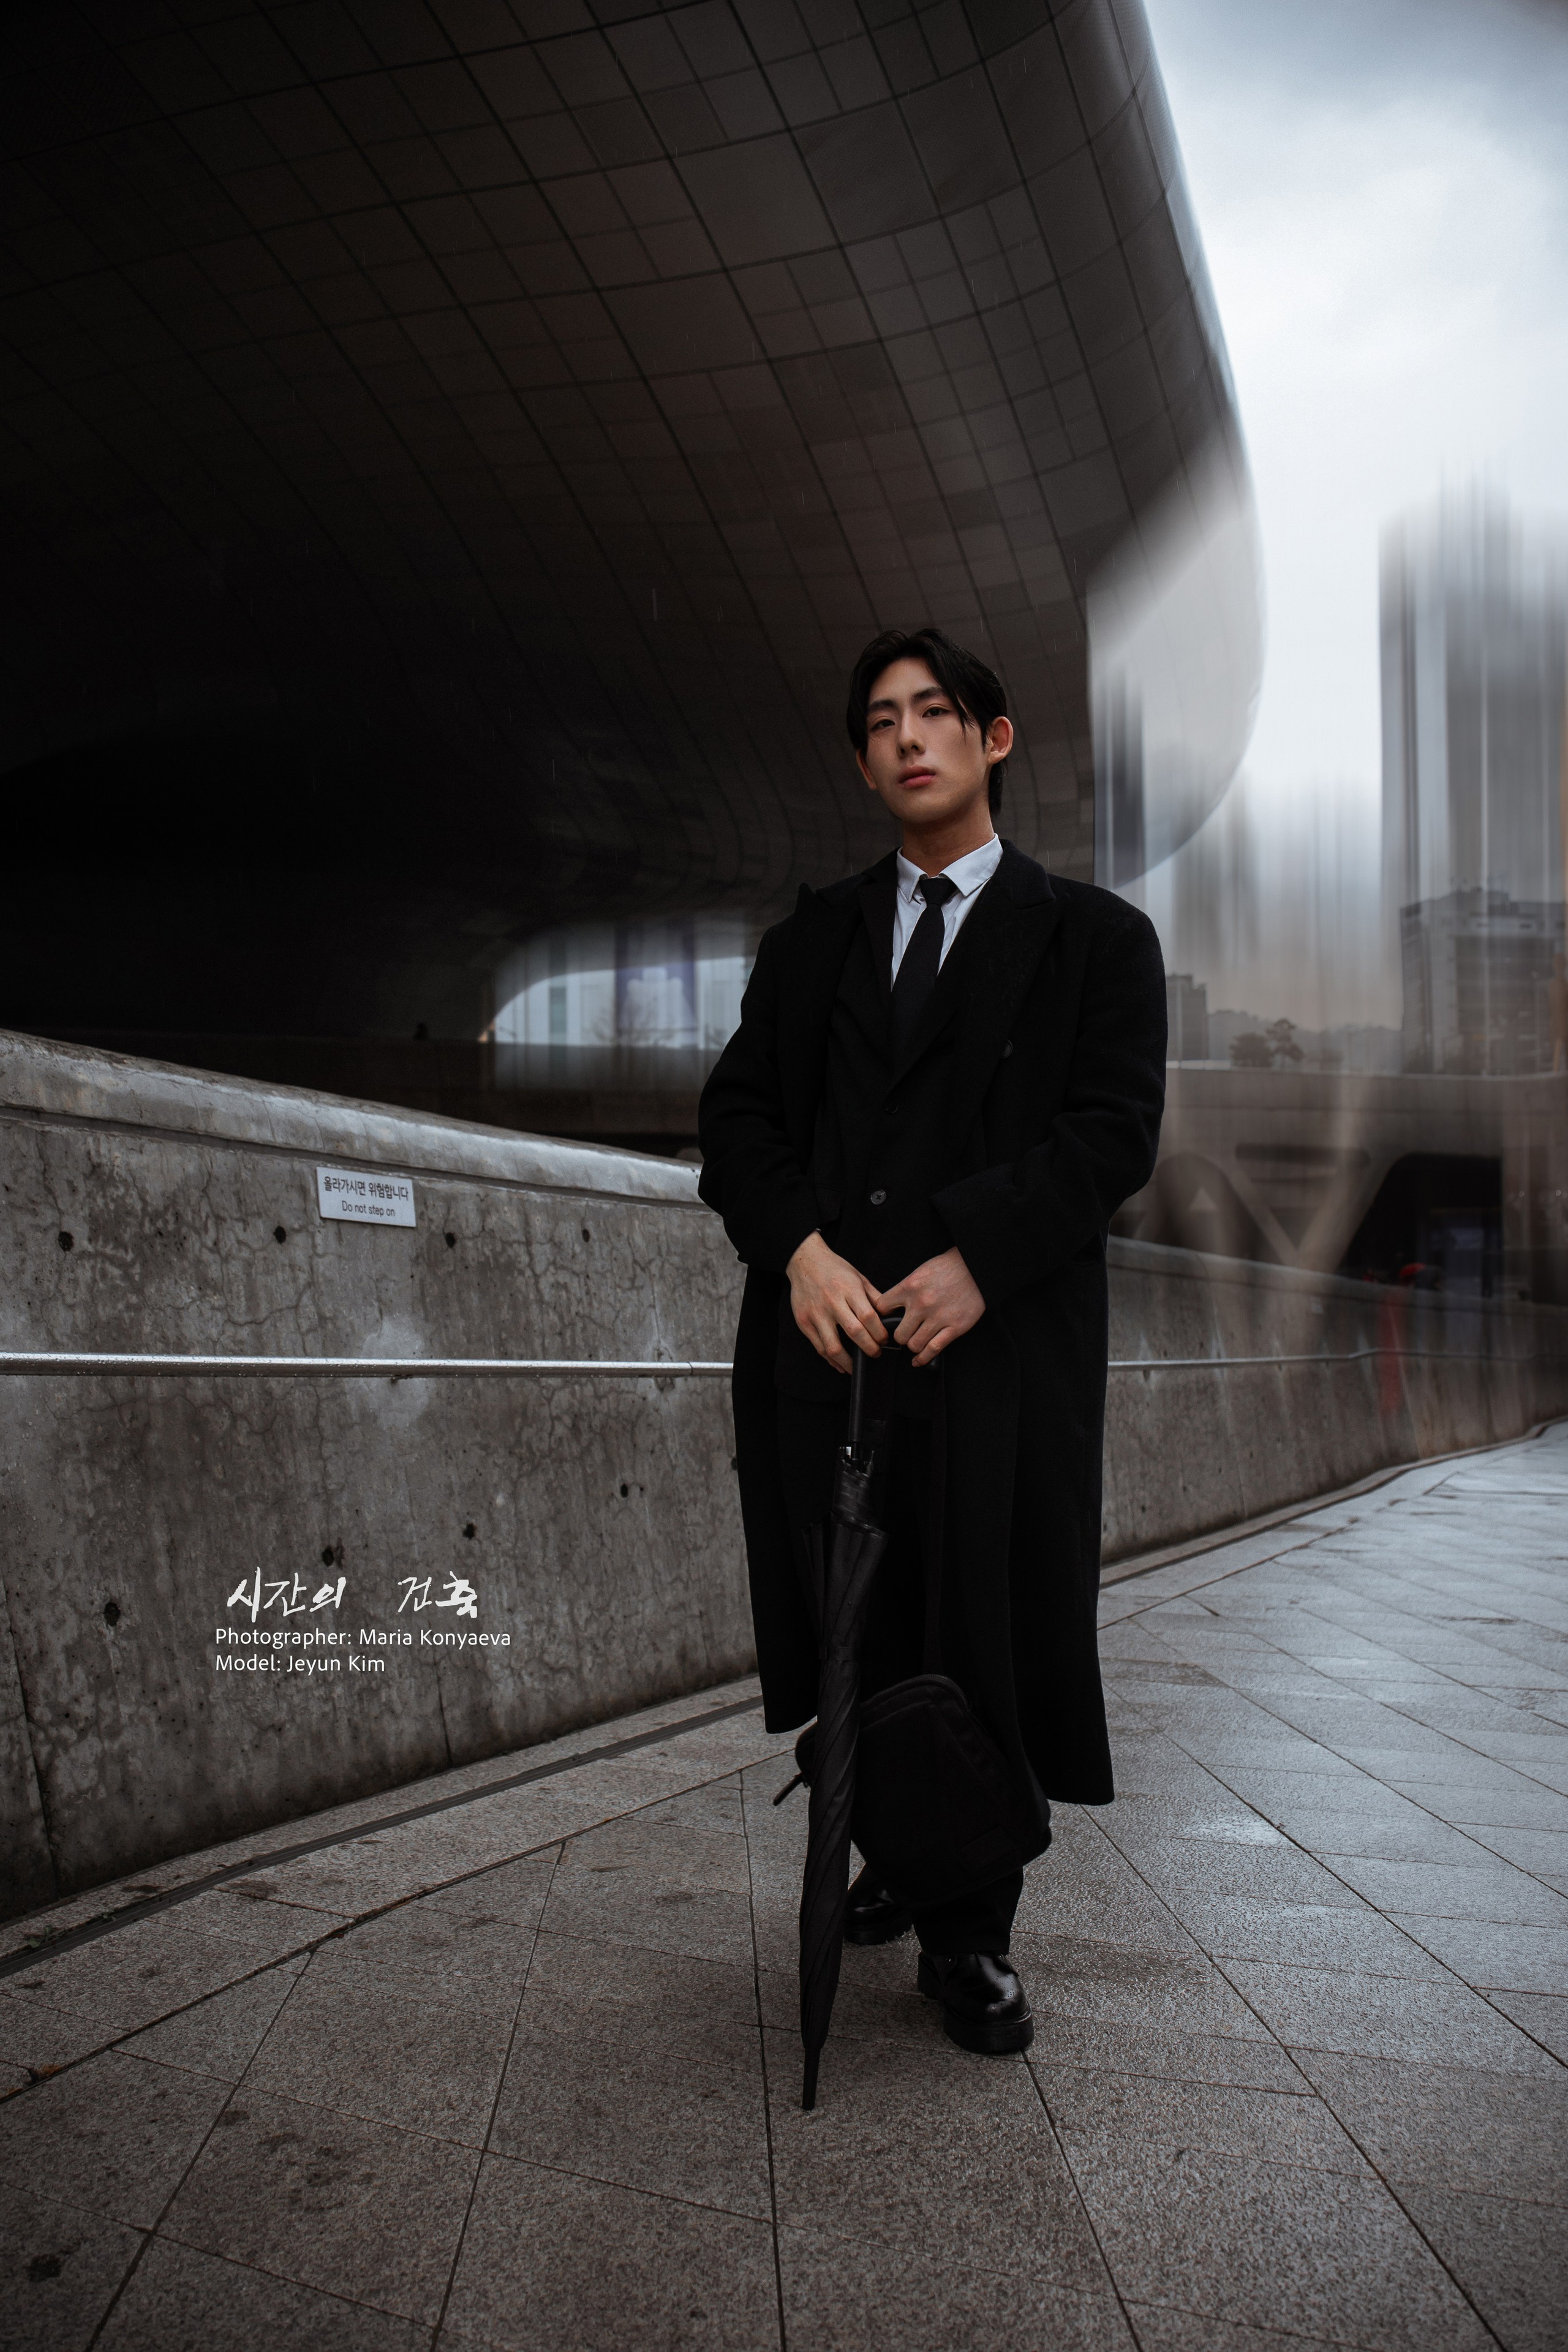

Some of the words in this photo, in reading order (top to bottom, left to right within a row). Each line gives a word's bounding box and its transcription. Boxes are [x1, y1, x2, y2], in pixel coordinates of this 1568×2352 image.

[323, 1176, 366, 1196] 올라가시면
[368, 1183, 409, 1200] 위험합니다
[342, 1200, 352, 1212] Do
[355, 1204, 366, 1213] not
[368, 1205, 384, 1216] step
[386, 1208, 395, 1216] on
